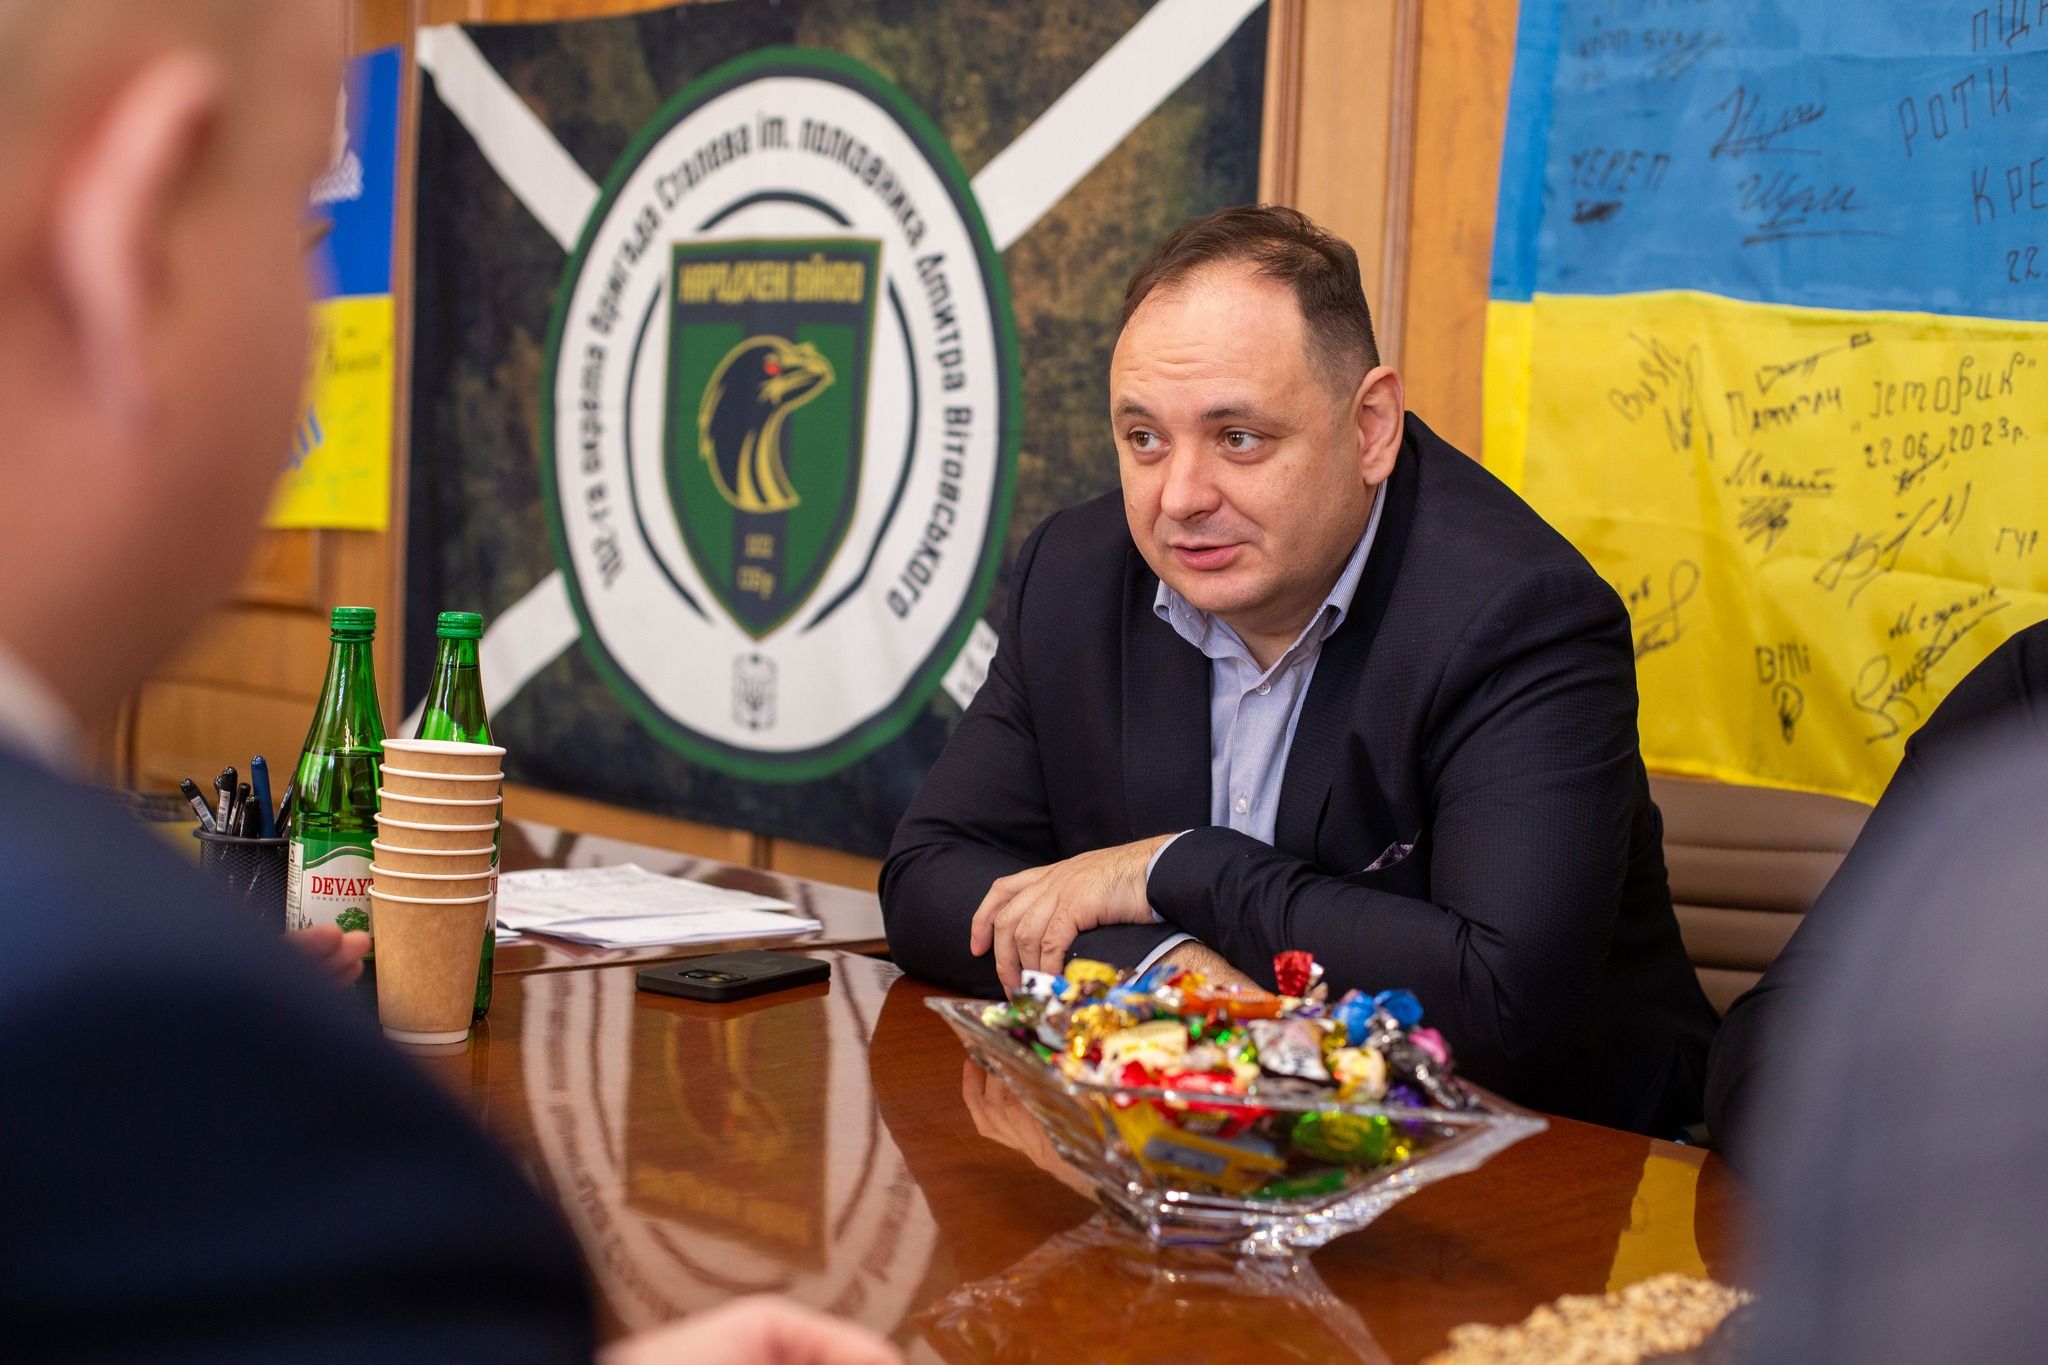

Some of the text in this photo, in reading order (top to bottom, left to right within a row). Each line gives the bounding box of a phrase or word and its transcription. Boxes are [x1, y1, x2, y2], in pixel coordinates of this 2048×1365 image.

[1897, 65, 2012, 160] РОТИ
[916, 252, 966, 392] Дмитра
[885, 406, 973, 620] Вітовського
